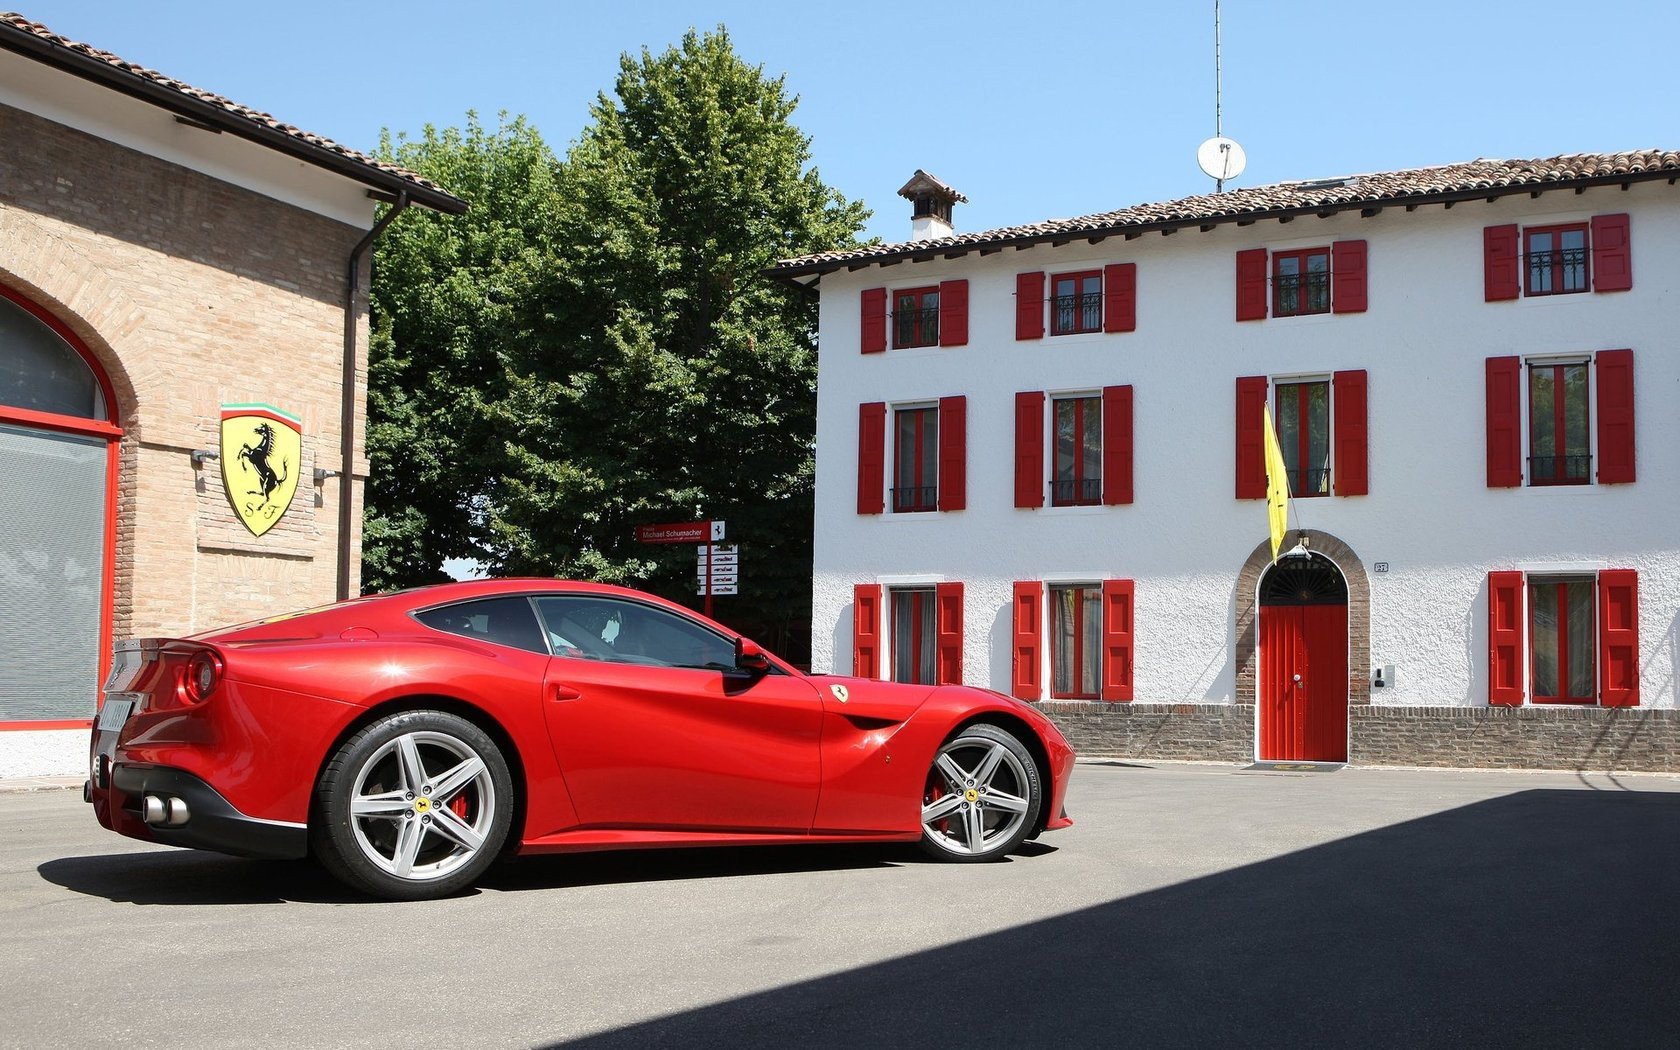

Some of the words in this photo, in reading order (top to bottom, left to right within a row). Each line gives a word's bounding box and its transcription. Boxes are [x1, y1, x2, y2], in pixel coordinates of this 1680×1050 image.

[244, 501, 254, 518] S
[263, 504, 282, 519] F
[642, 531, 665, 539] Michael
[666, 529, 702, 538] Schumacher
